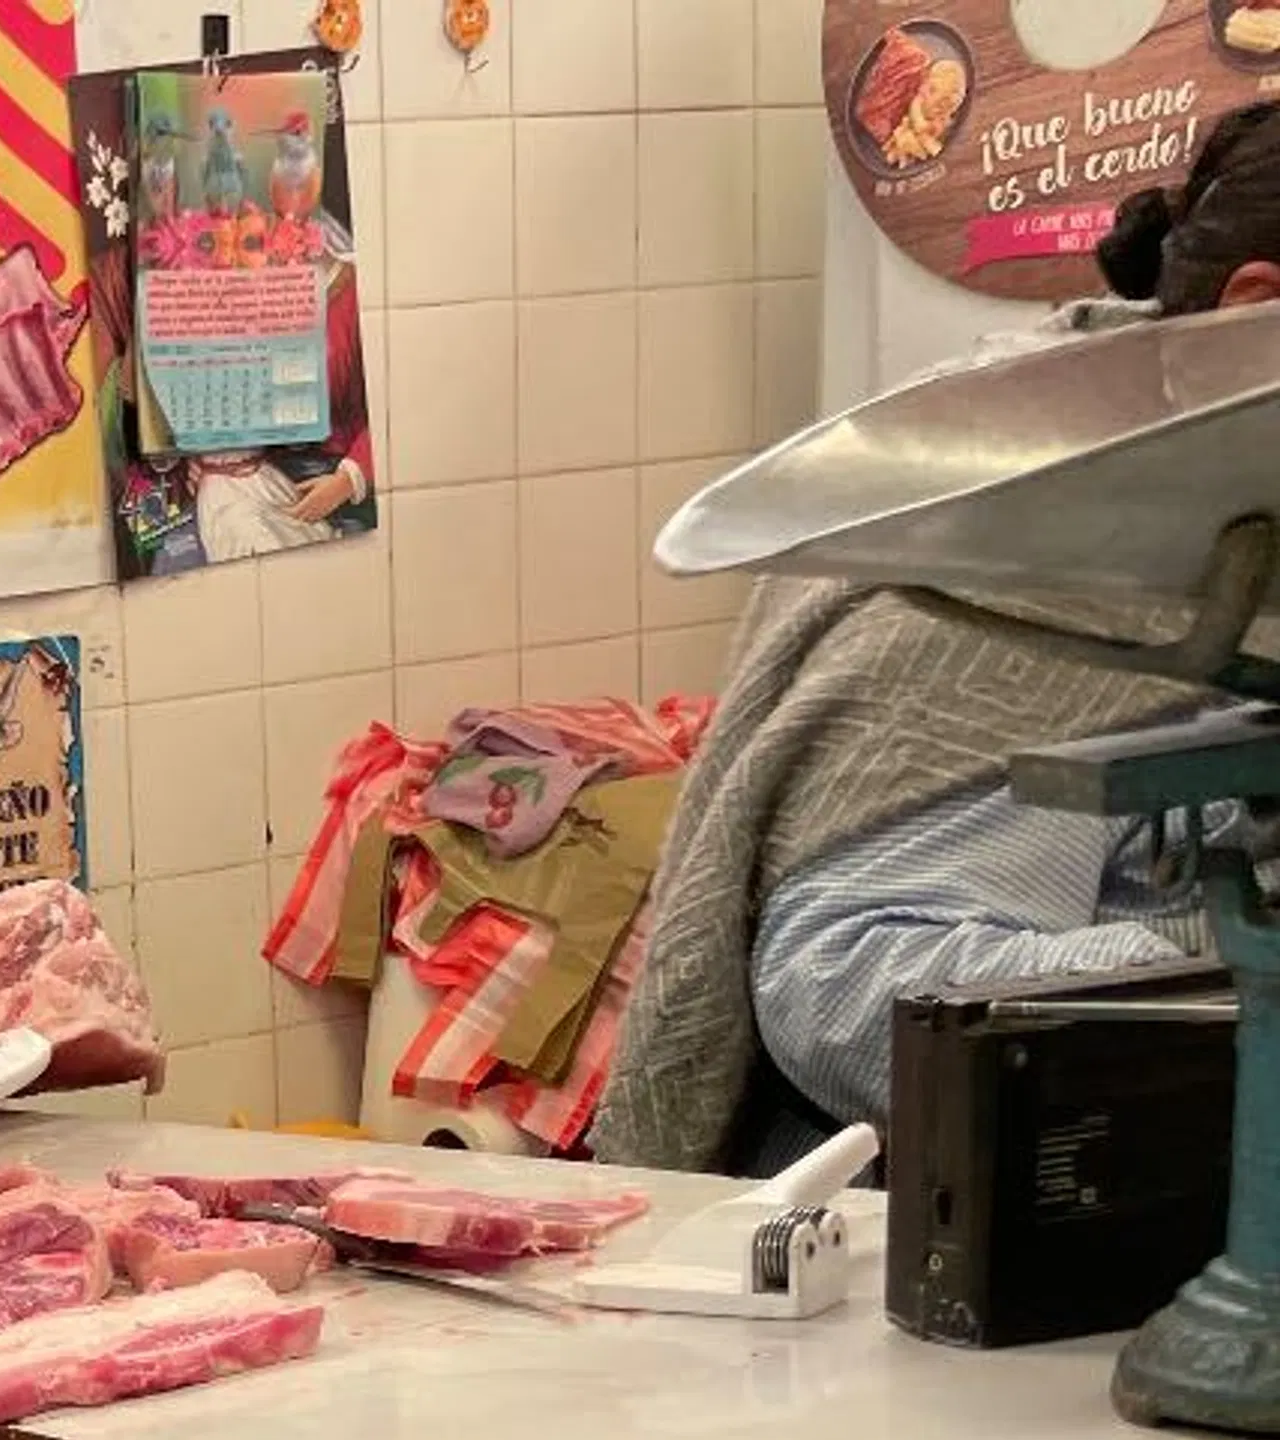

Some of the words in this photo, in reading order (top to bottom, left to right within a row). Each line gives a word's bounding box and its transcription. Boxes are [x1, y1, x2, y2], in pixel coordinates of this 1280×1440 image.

[979, 115, 1072, 175] ¡Que
[1084, 80, 1196, 137] bueno
[989, 175, 1025, 212] es
[1037, 143, 1073, 195] el
[1084, 116, 1197, 183] cerdo!
